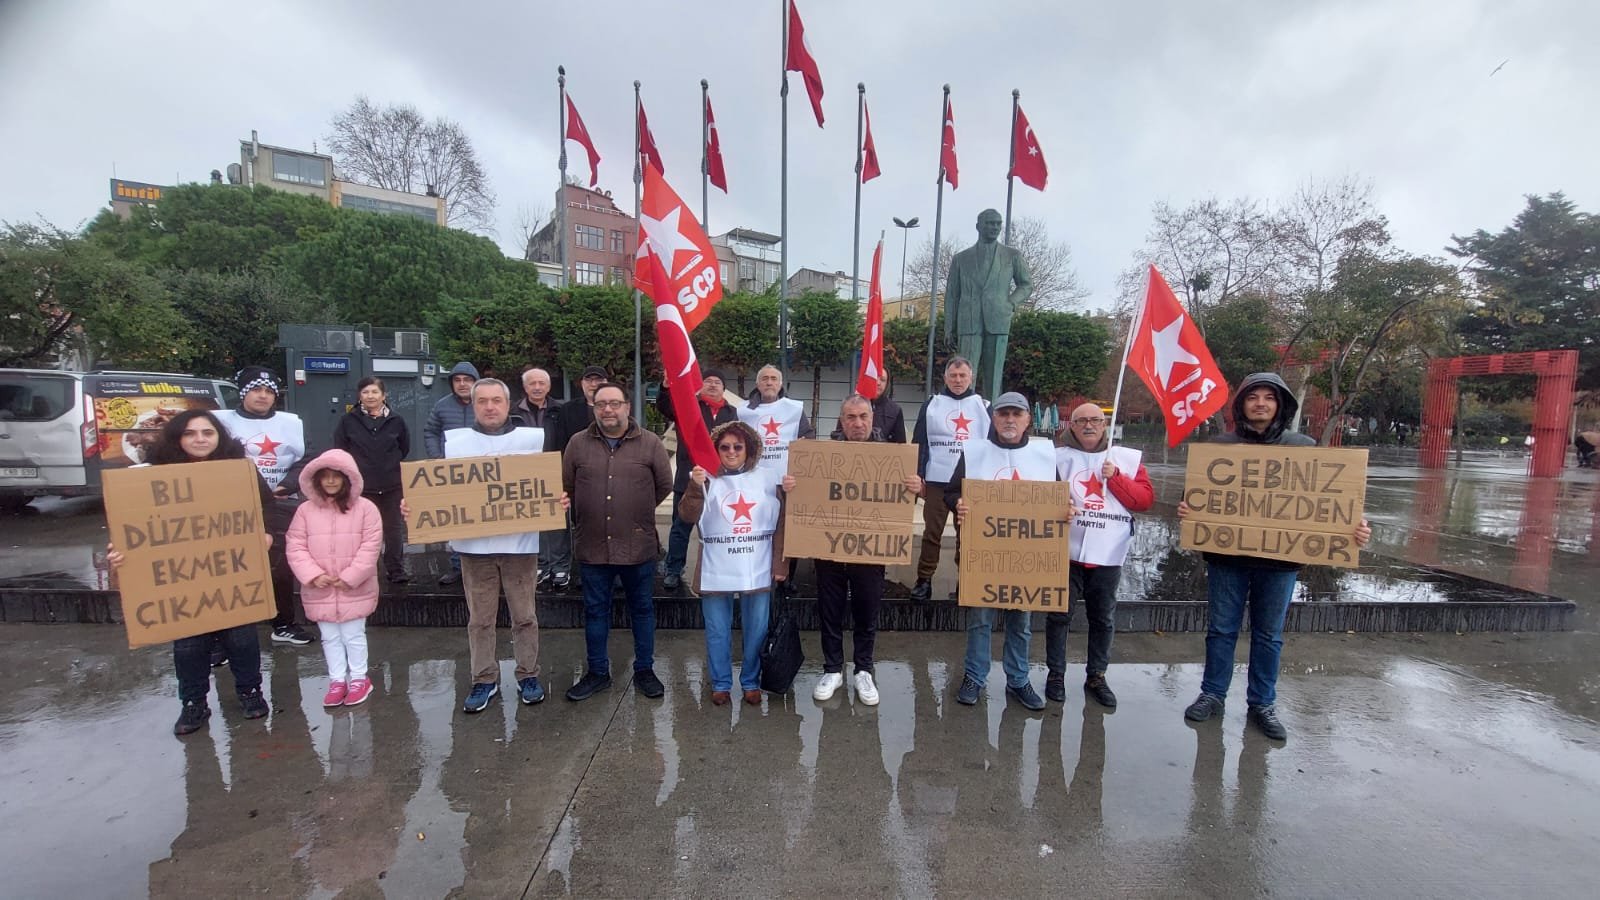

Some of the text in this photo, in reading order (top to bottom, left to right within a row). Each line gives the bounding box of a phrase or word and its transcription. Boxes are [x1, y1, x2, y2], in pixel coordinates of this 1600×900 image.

[677, 266, 716, 313] SCP
[1171, 377, 1217, 426] SCP
[257, 459, 277, 467] SCP
[409, 457, 501, 489] ASGARİ
[793, 450, 907, 481] SARAYA
[1207, 457, 1346, 493] CEBİNİZ
[151, 477, 194, 507] BU
[487, 477, 554, 502] DEĞİL
[829, 481, 910, 505] BOLLUK
[415, 498, 561, 529] ADİL ÜCRET
[793, 503, 888, 531] HALKA
[1084, 502, 1105, 511] SCP
[1185, 487, 1354, 526] CEBİMİZDEN
[123, 510, 257, 550] DÜZENDEN
[733, 526, 752, 534] SCP
[983, 516, 1069, 539] SEFALET
[1076, 519, 1106, 529] PARTİSİ
[728, 545, 754, 554] PARTİSİ
[824, 531, 910, 557] YOKLUK
[1193, 522, 1351, 562] DOLUYOR
[151, 547, 249, 587] EKMEK
[966, 549, 1063, 574] PATRONA
[136, 580, 265, 629] ÇIKMAZ
[981, 584, 1067, 607] SERVET
